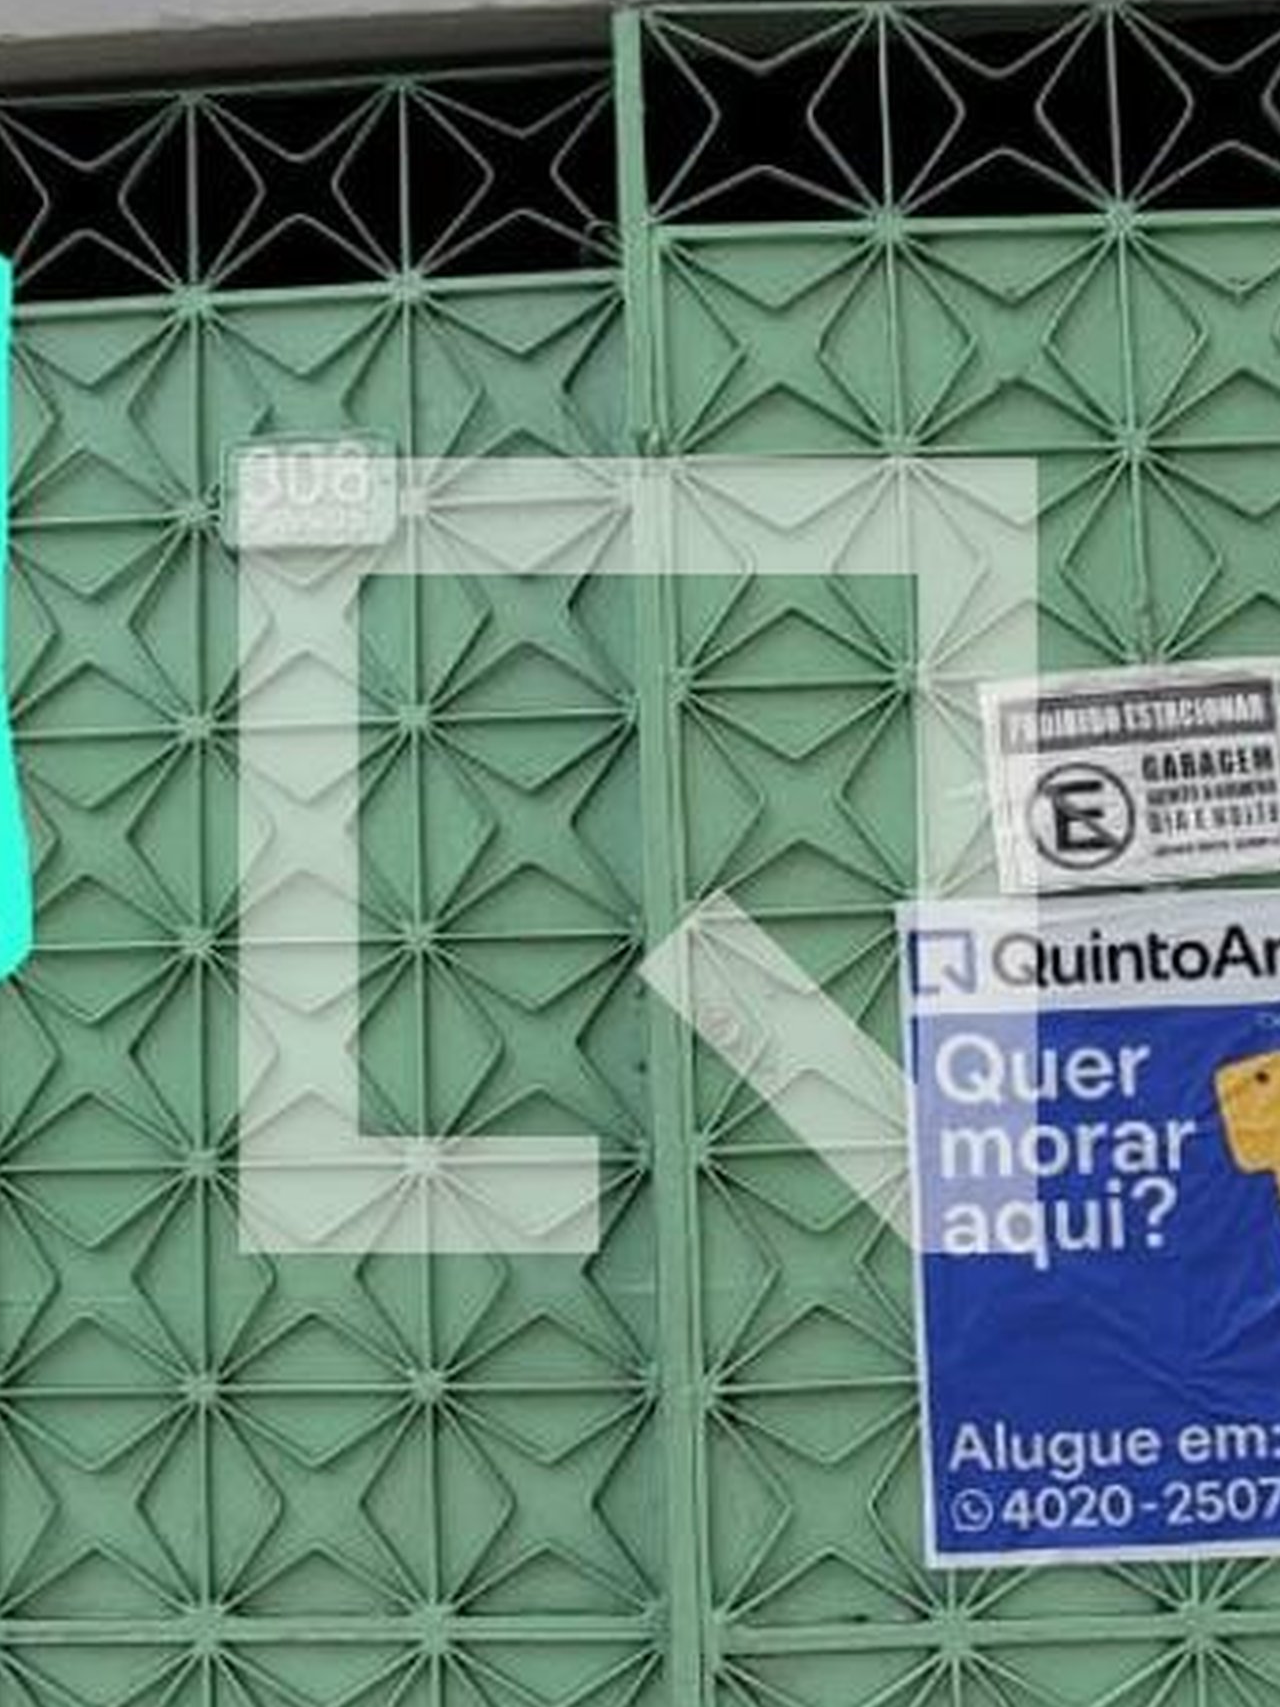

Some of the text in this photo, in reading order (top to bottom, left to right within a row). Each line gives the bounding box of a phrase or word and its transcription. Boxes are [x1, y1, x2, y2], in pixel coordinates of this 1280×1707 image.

[1142, 745, 1275, 782] GARAGEM
[934, 1032, 1151, 1103] Quer
[939, 1118, 1198, 1180] morar
[940, 1177, 1179, 1271] aqui?
[949, 1421, 1162, 1481] Alugue
